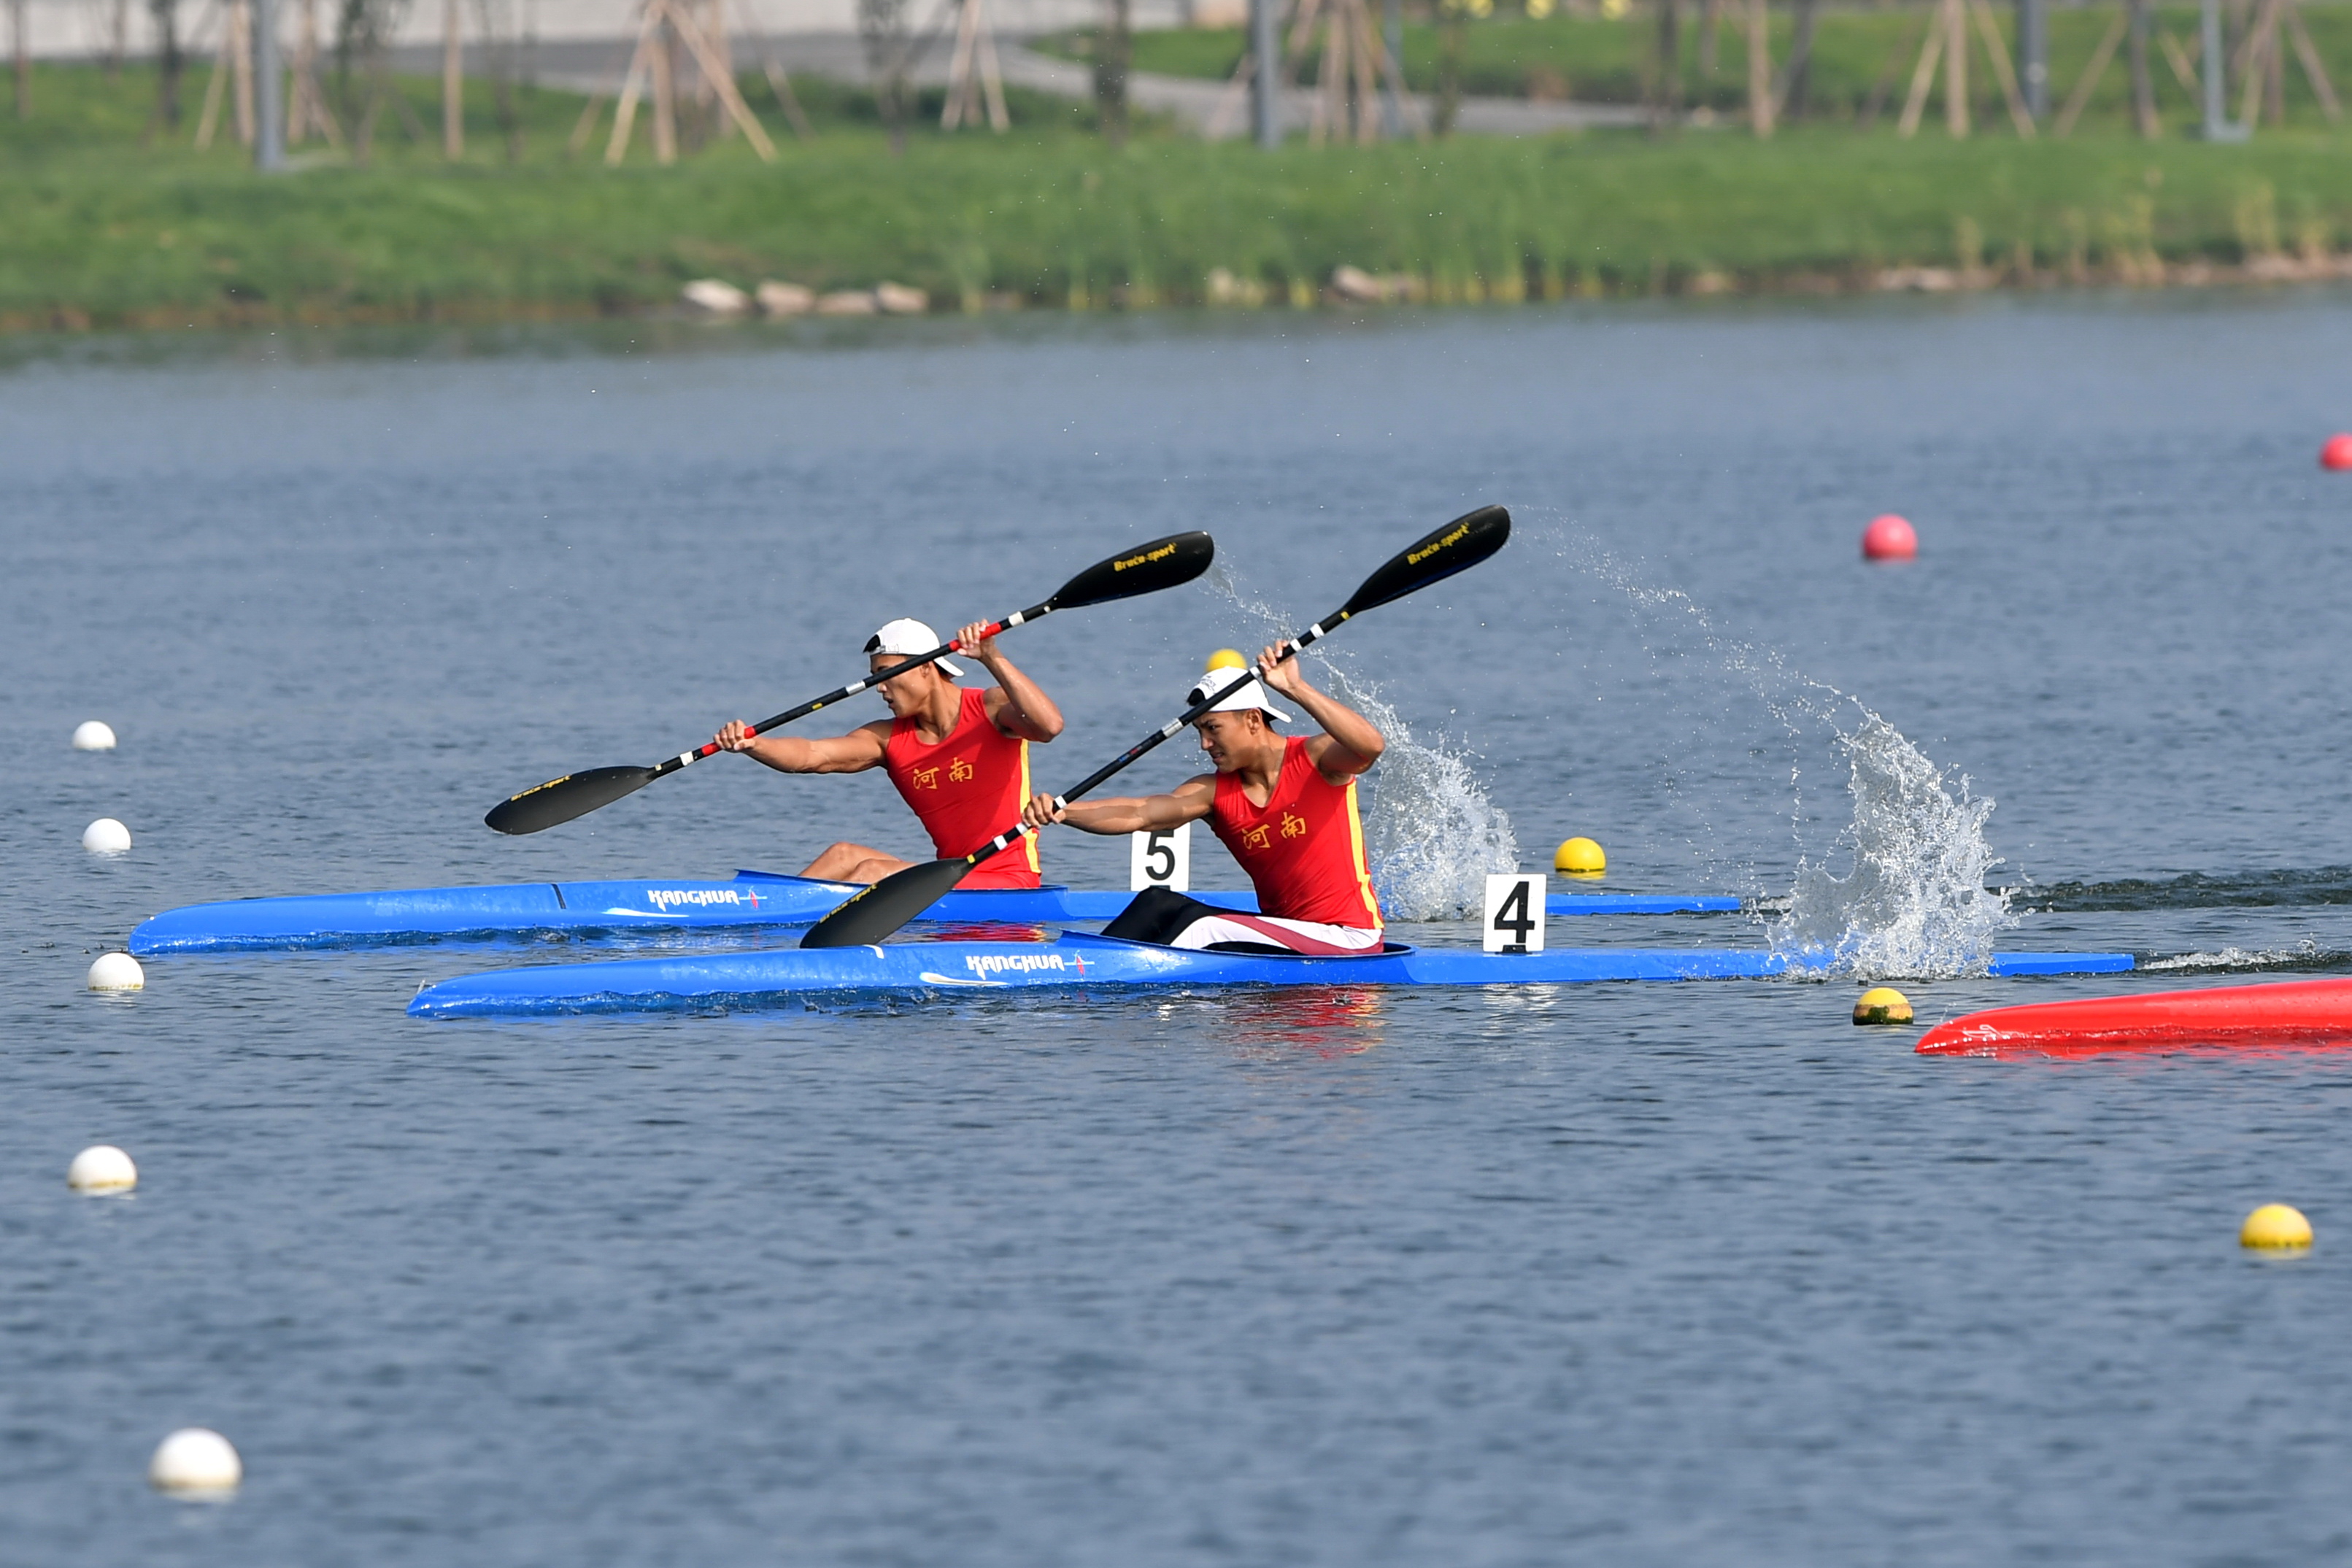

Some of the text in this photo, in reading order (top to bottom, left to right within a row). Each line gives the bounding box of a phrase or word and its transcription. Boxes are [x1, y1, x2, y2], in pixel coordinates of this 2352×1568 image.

[913, 757, 973, 789] 河南
[1241, 811, 1306, 850] 河南
[1145, 829, 1175, 881] 5
[647, 890, 740, 912] KANGHUA
[1494, 881, 1535, 943] 4
[965, 954, 1065, 981] KANGHUA
